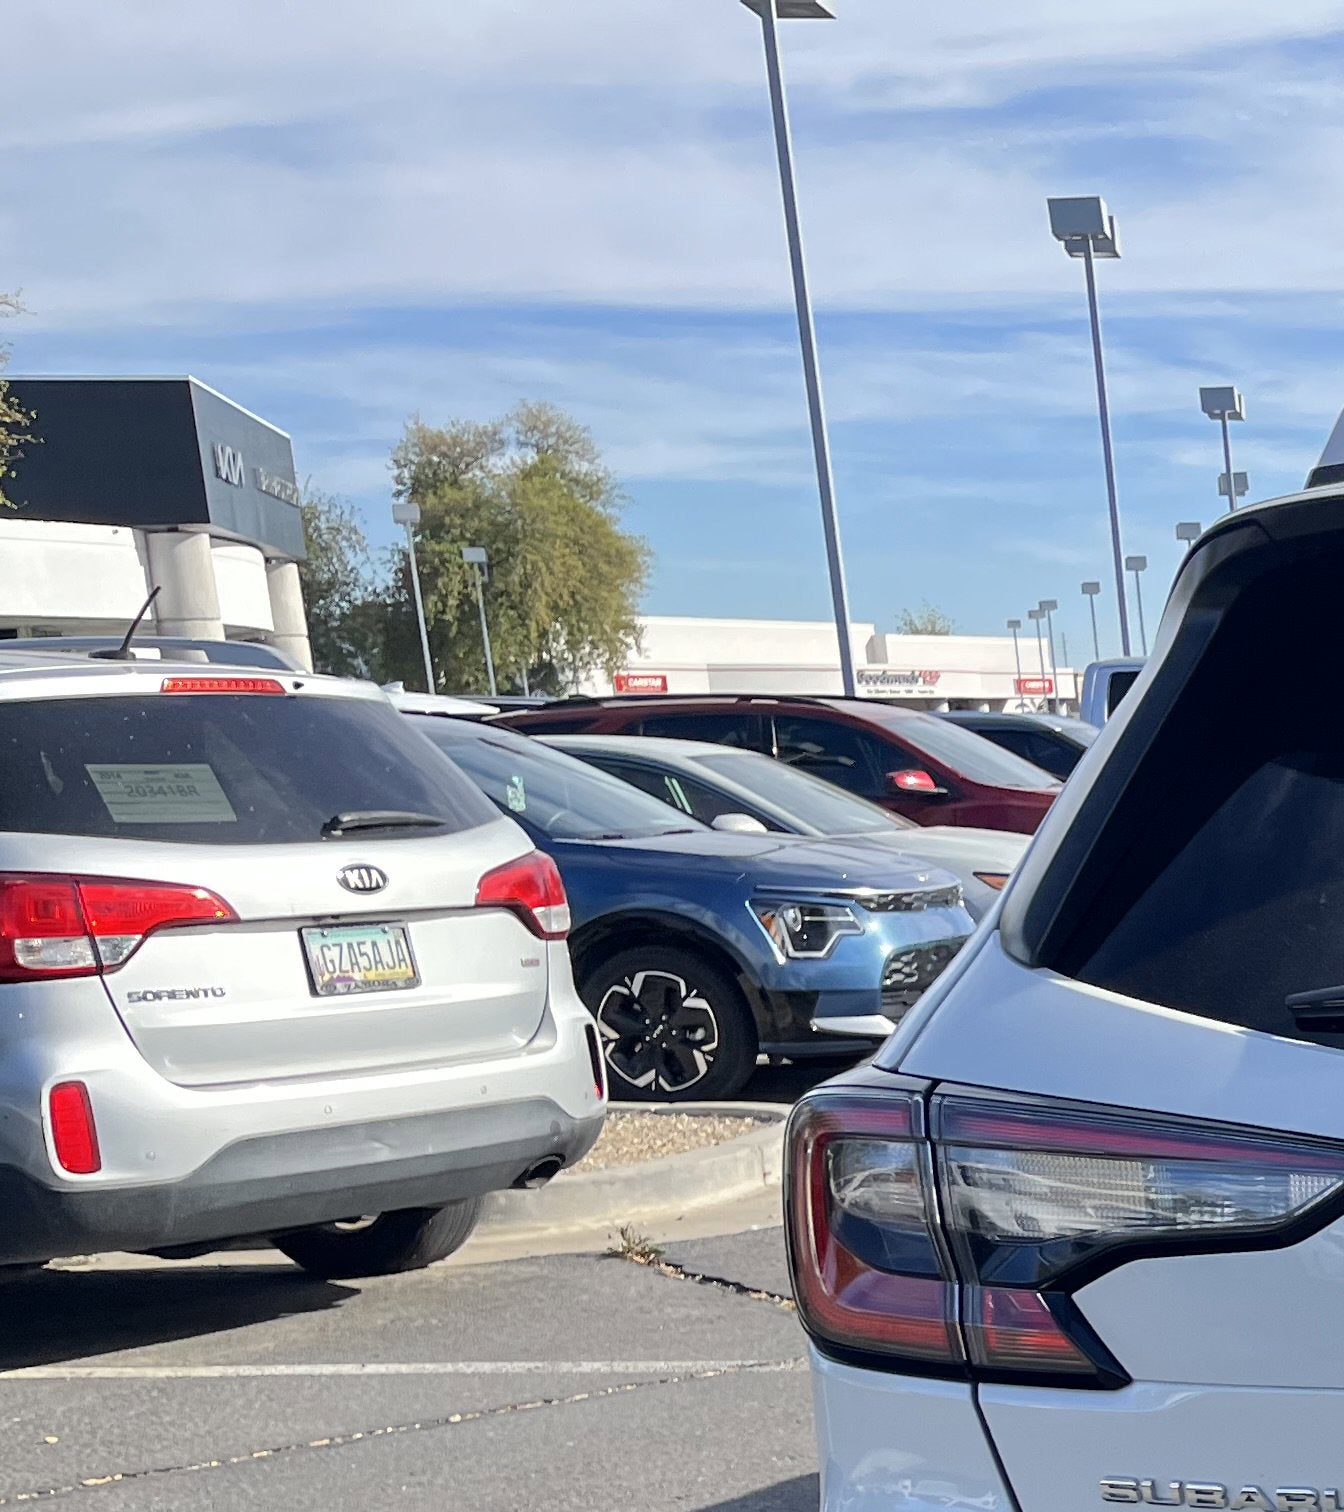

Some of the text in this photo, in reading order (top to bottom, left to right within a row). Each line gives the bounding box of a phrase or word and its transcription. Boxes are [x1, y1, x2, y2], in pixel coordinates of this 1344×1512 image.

[344, 868, 384, 889] KIA
[320, 938, 409, 974] GZA5AJA
[127, 986, 226, 1003] SORENTO
